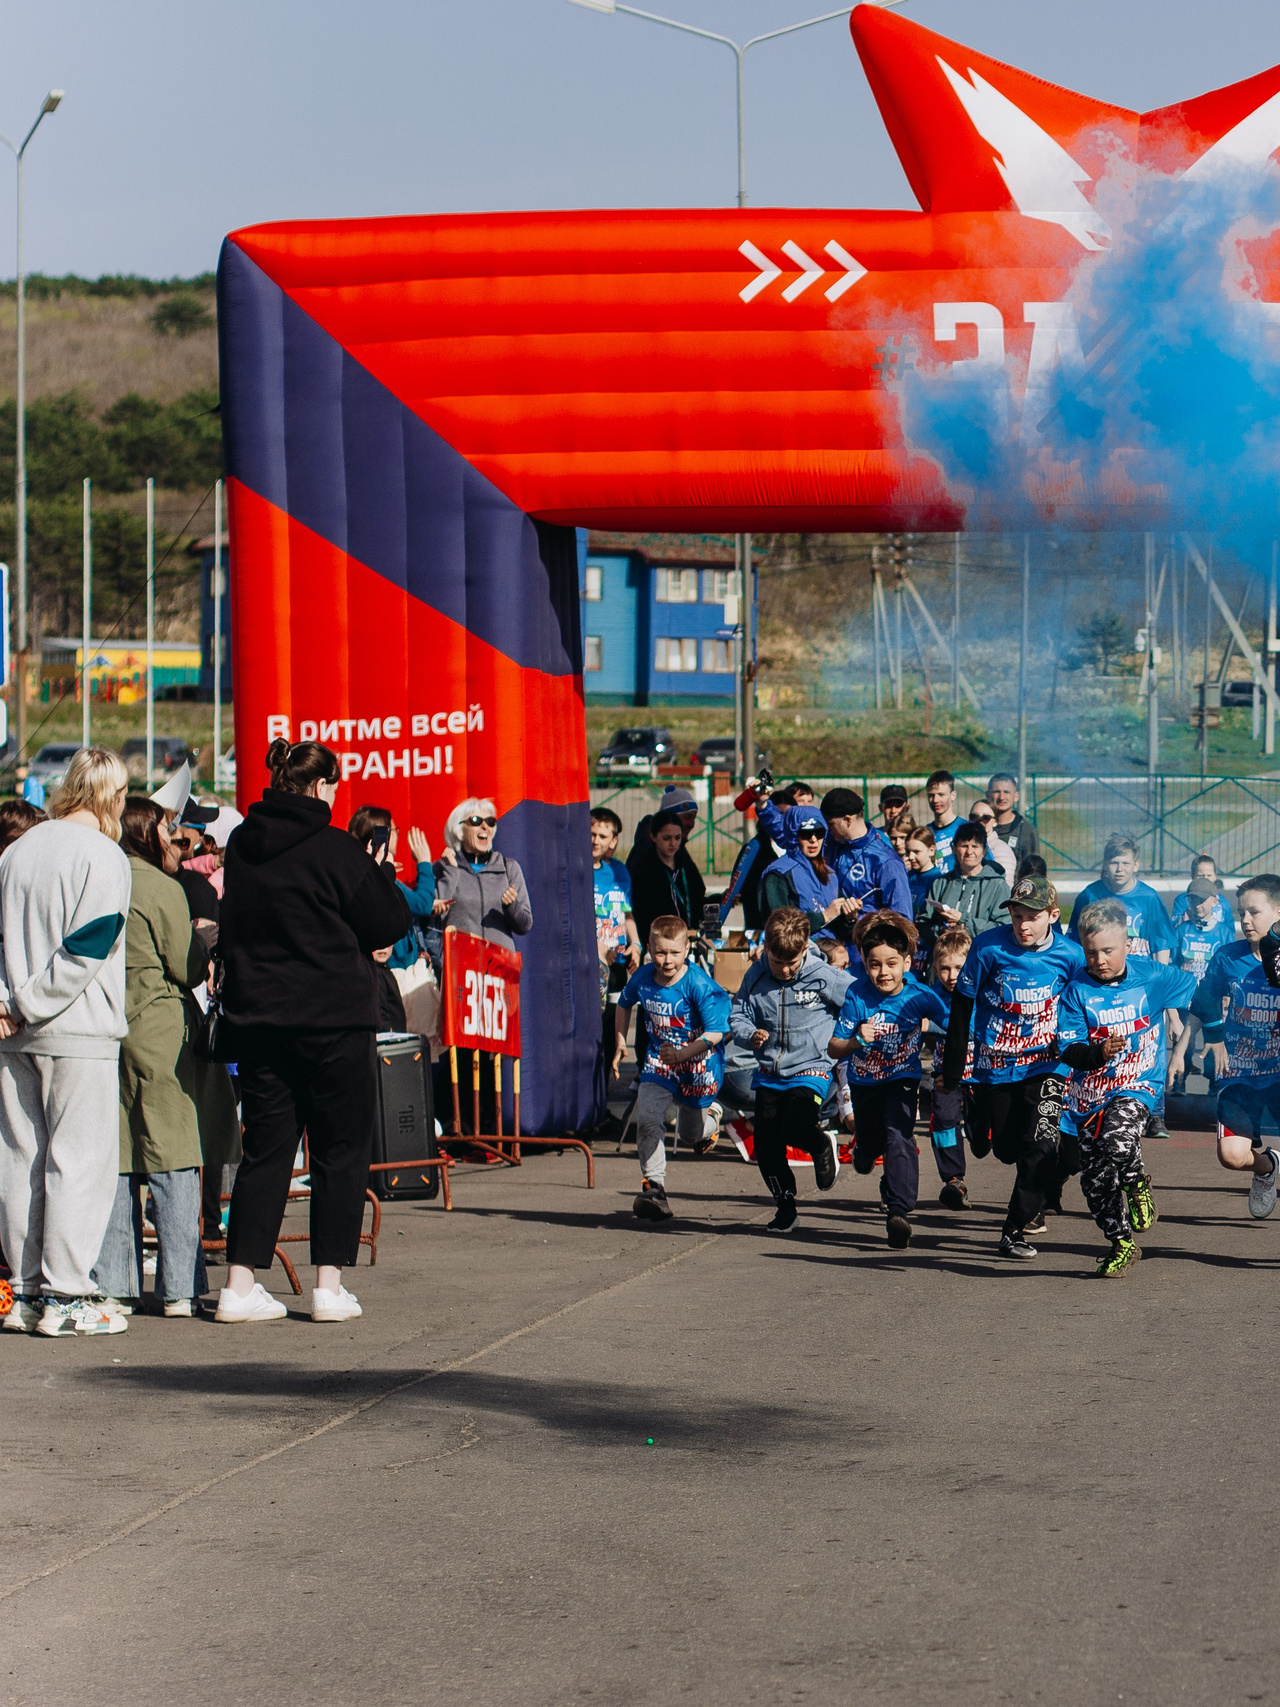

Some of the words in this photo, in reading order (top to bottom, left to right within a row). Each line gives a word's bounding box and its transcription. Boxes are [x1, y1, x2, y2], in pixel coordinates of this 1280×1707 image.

[267, 715, 291, 744] В
[300, 716, 402, 742] ритме
[411, 703, 484, 737] всей
[338, 745, 453, 782] РАНЫ!
[1015, 985, 1051, 1002] 00525
[645, 998, 673, 1016] 00521
[1099, 1004, 1137, 1026] 00516
[399, 1104, 415, 1134] JBL
